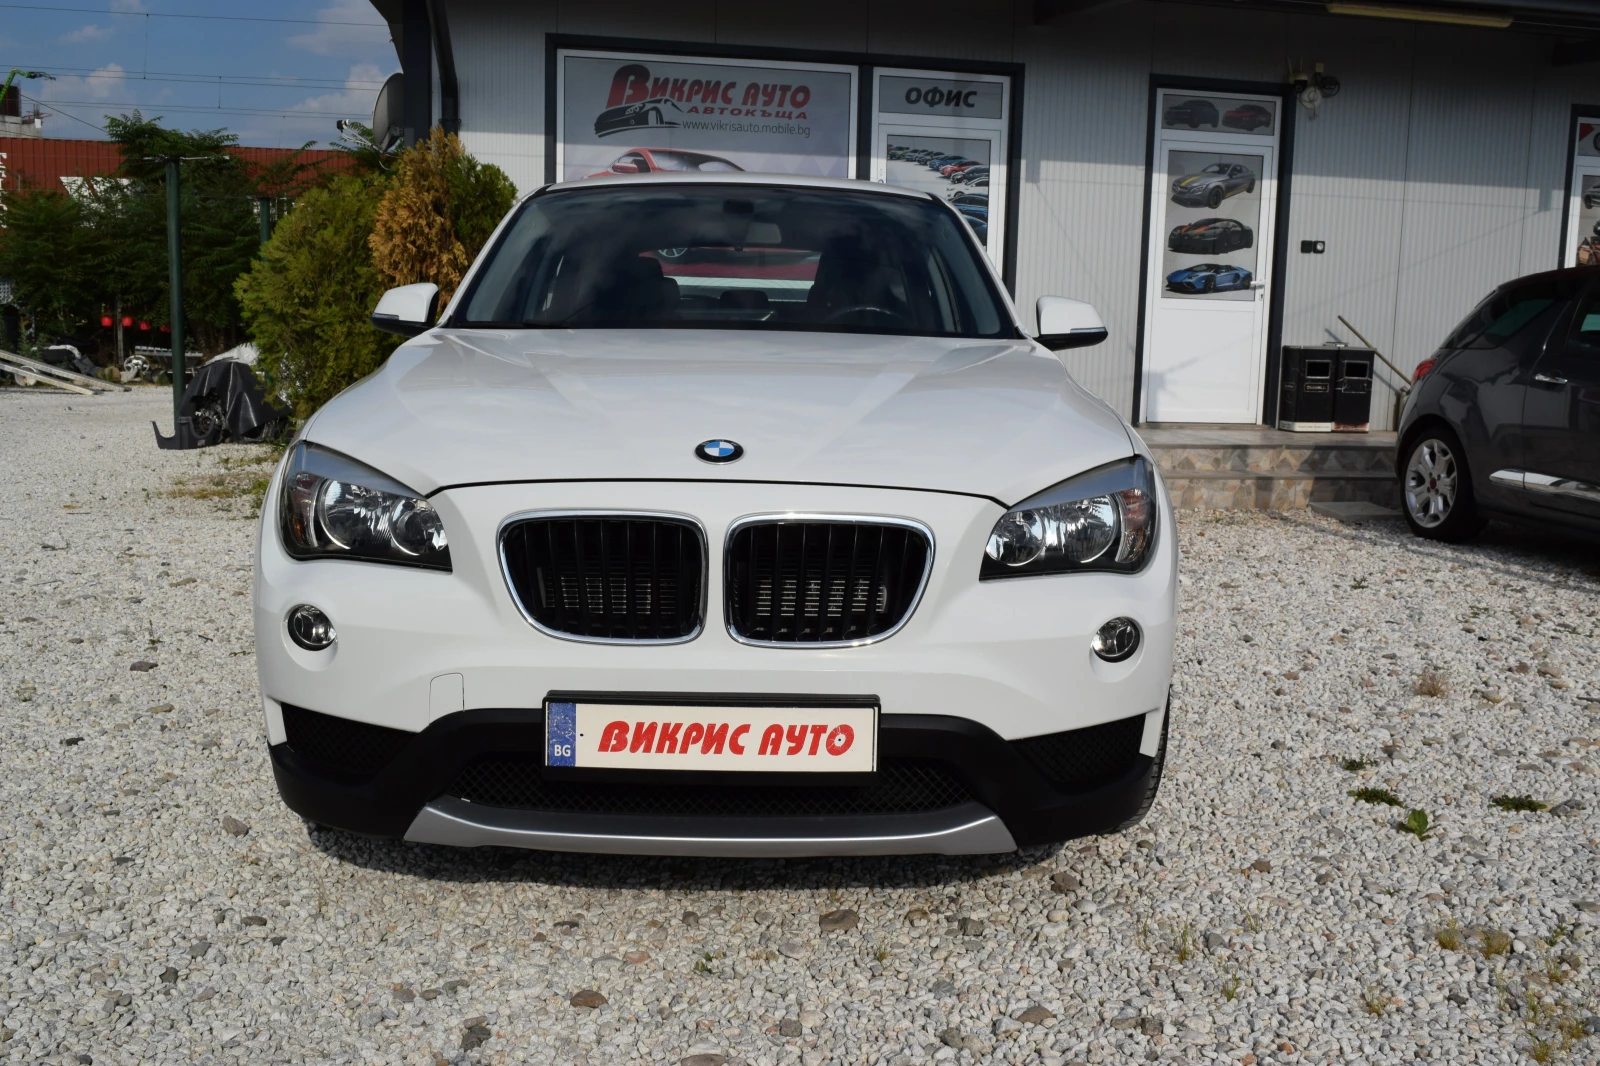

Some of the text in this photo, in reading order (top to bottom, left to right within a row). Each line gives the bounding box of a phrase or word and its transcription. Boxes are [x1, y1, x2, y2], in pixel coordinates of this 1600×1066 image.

[905, 86, 977, 108] ОФИС
[687, 105, 808, 120] АВТОКЪЩА
[682, 119, 811, 139] www.vikrisauto.mobile.bg
[597, 720, 855, 757] ВИКРИС АУТО
[554, 744, 571, 757] BG
